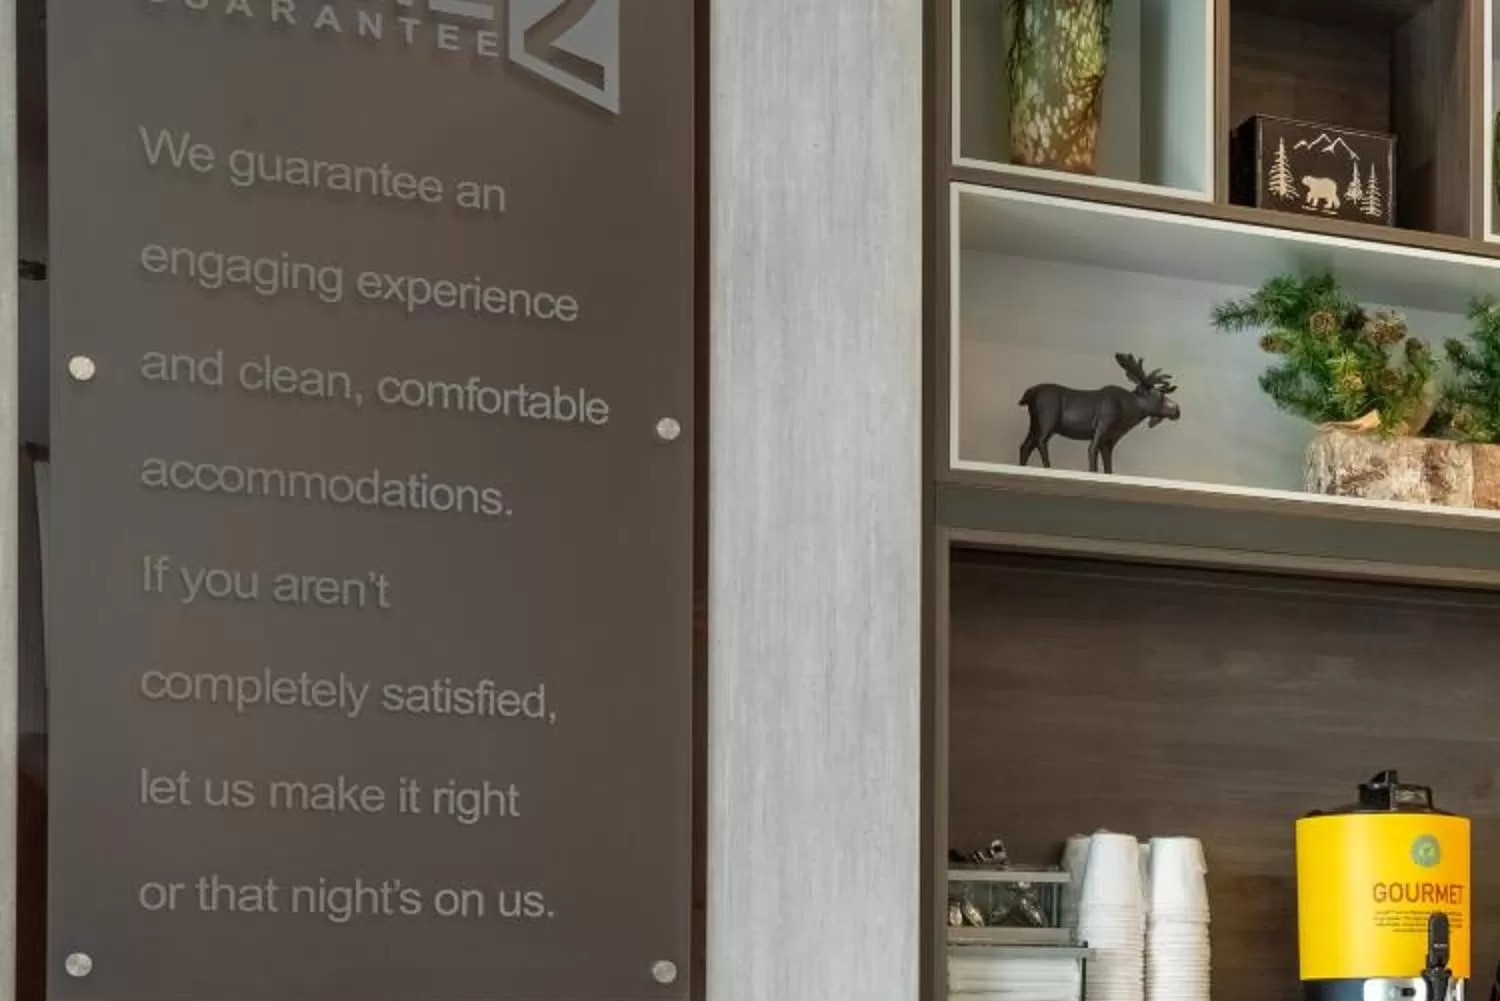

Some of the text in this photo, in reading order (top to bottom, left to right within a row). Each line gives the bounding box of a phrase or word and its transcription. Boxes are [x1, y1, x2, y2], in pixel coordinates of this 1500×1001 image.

[146, 0, 500, 57] ARANTEE
[139, 126, 506, 213] We guarantee an
[141, 245, 579, 323] engaging experience
[141, 350, 610, 425] and clean, comfortable
[141, 456, 513, 516] accommodations.
[143, 555, 168, 593] If
[180, 565, 259, 603] you
[140, 667, 557, 725] completely satisfied,
[140, 768, 519, 824] let us make it right
[139, 880, 184, 909] or
[195, 876, 278, 912] that
[435, 883, 485, 916] on
[499, 888, 556, 918] us.
[1373, 882, 1464, 904] GOURMET
